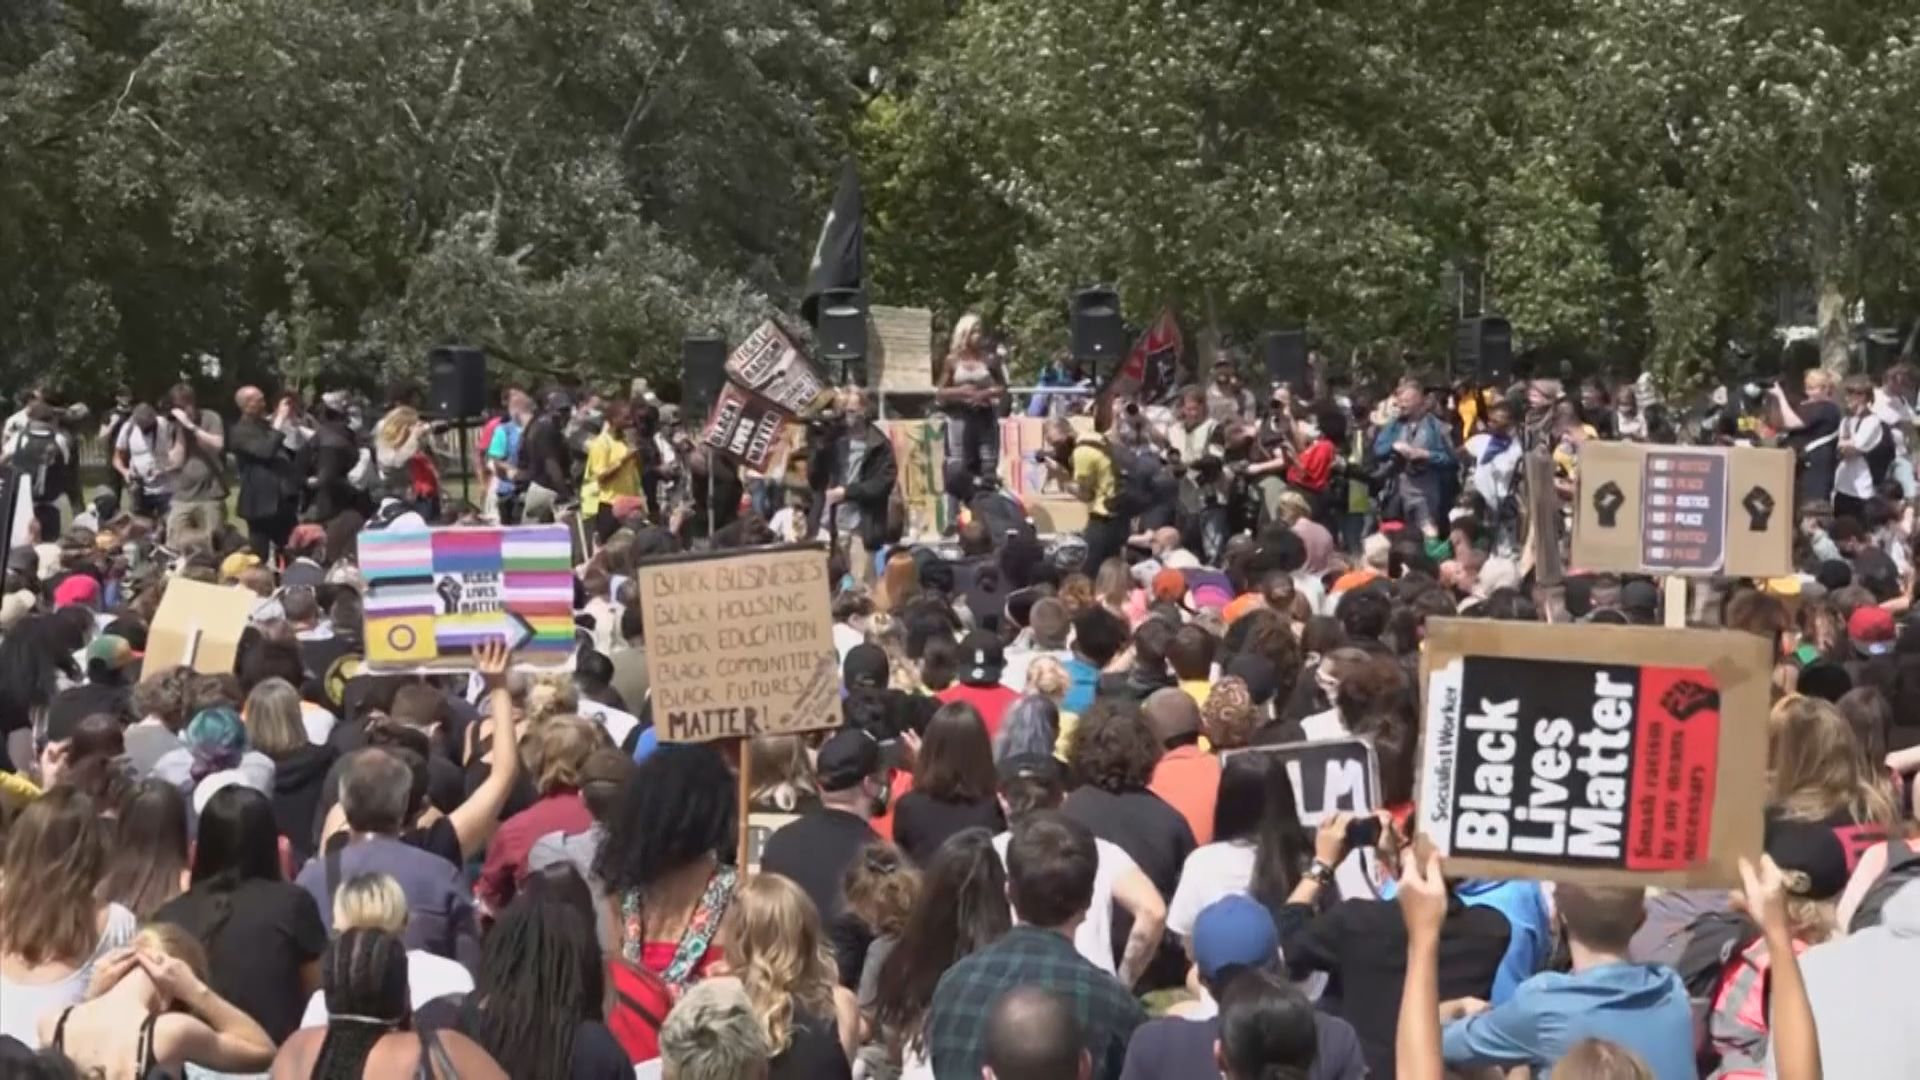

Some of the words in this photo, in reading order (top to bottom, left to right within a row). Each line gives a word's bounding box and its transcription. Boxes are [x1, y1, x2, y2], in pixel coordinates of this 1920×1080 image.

[711, 401, 738, 446] BLACK
[729, 418, 754, 455] LIVES
[748, 411, 780, 461] MATTER
[466, 586, 497, 599] LIVES
[654, 572, 711, 597] BLACK
[655, 604, 710, 627] BLACK
[718, 592, 808, 621] HOUSING
[656, 633, 710, 657] BLACK
[718, 622, 817, 649] EDUCATION
[657, 662, 710, 684] BLACK
[659, 686, 715, 709] BLACK
[726, 676, 804, 701] FUTURES
[668, 706, 771, 739] MATTER!
[1437, 686, 1458, 748] Worker
[1455, 698, 1520, 850] Black
[1567, 671, 1634, 858] Matter
[1645, 721, 1663, 788] racism
[1667, 729, 1685, 792] means
[1431, 750, 1453, 823] Socialist
[1511, 717, 1575, 856] Lives
[1634, 795, 1657, 858] Smash
[1663, 799, 1681, 833] any
[1658, 836, 1677, 861] by
